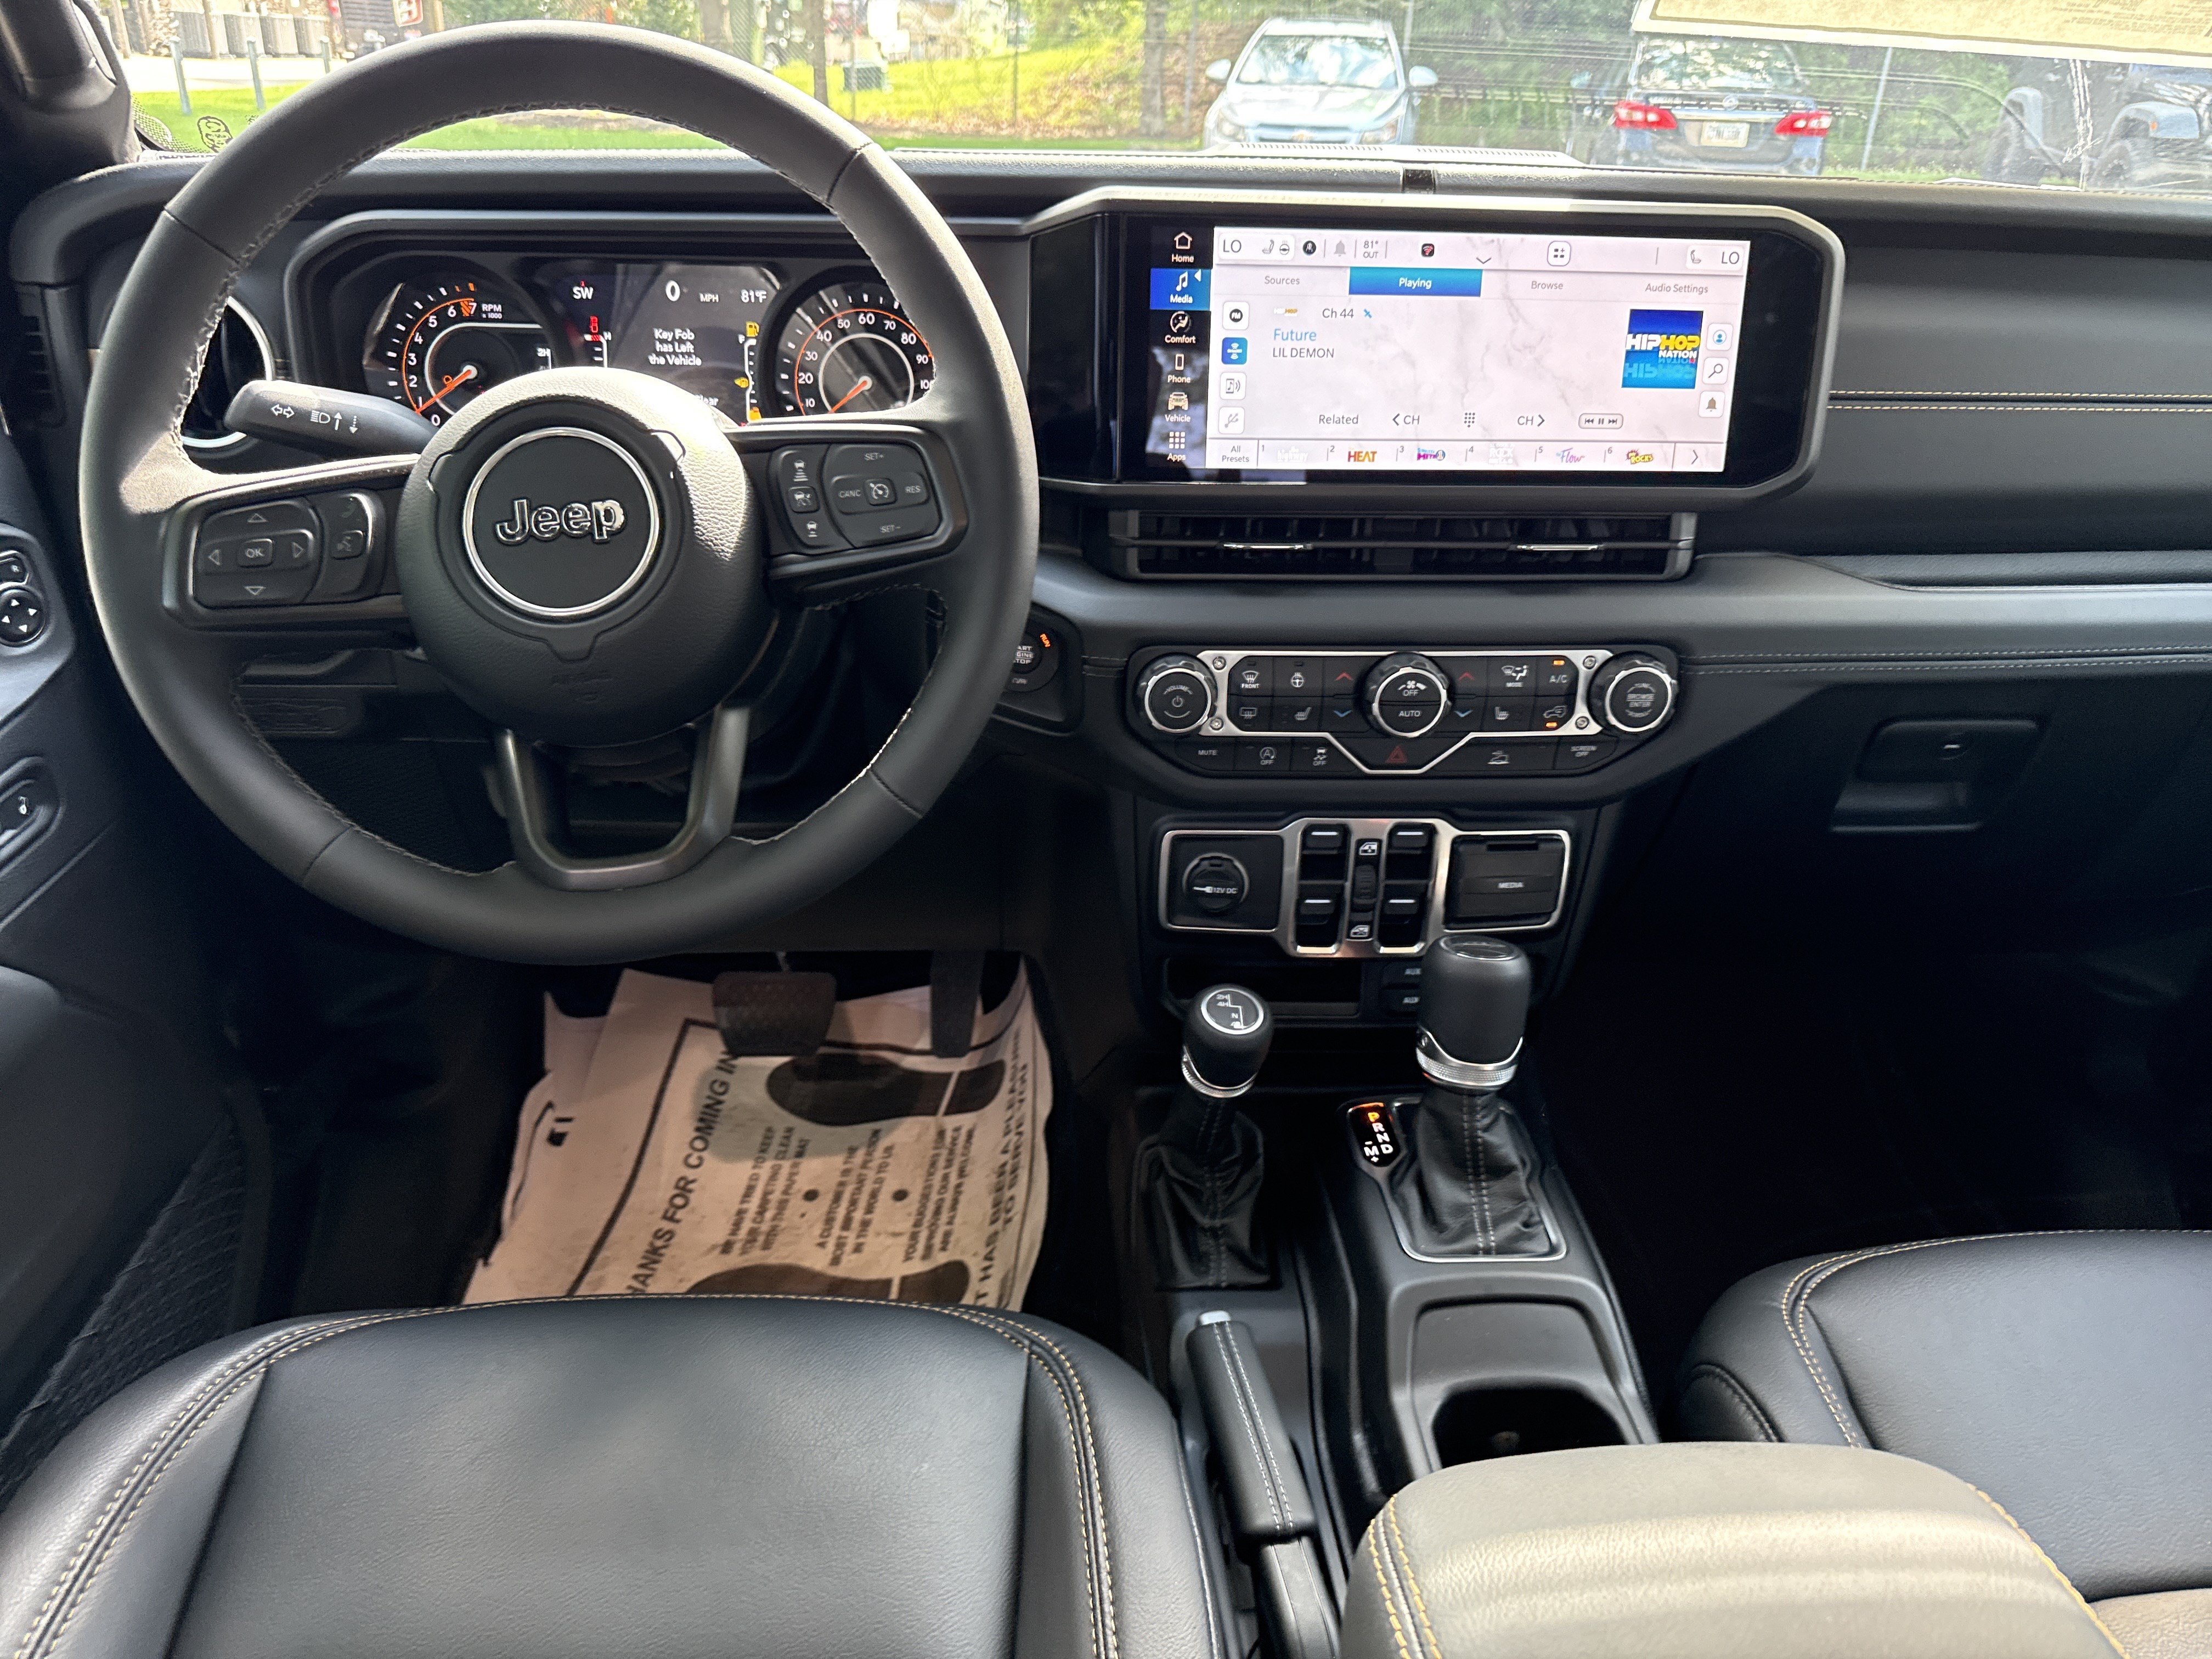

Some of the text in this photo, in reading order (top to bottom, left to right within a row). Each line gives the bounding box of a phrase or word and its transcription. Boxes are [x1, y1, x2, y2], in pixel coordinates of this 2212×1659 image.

[1223, 240, 1242, 253] LO
[1171, 253, 1194, 263] Home
[1721, 252, 1740, 265] LO
[1265, 276, 1300, 285] Sources
[1399, 278, 1432, 289] Playing
[1531, 281, 1564, 290] Browse
[573, 286, 593, 299] SW
[665, 280, 680, 301] 0
[1645, 284, 1708, 295] Audio Settings
[699, 293, 719, 303] MPH
[1170, 295, 1193, 304] Media
[448, 306, 456, 318] 6
[469, 303, 477, 314] 7
[482, 303, 502, 313] RPM
[1322, 308, 1354, 318] Ch 44
[428, 316, 437, 328] 5
[837, 319, 850, 329] 50
[858, 314, 875, 325] 60
[884, 320, 896, 330] 70
[414, 333, 423, 344] 4
[654, 329, 695, 341] Key Fob
[816, 331, 832, 342] 40
[901, 333, 916, 345] 80
[1165, 334, 1195, 344] Comfort
[1274, 328, 1317, 341] Future
[656, 342, 695, 353] has Left
[1273, 347, 1335, 358] LIL DEMON
[408, 354, 417, 365] 3
[648, 354, 702, 366] the Vehicle
[805, 352, 818, 362] 30
[916, 354, 929, 364] 90
[1658, 350, 1697, 359] NATION
[409, 376, 417, 387] 2
[798, 373, 814, 384] 20
[1167, 375, 1191, 383] Phone
[805, 398, 815, 408] 10
[431, 415, 441, 426] 0
[1165, 414, 1190, 422] Vehicle
[1319, 415, 1359, 425] Related
[1403, 415, 1420, 425] CH
[1517, 416, 1534, 426] CH
[1167, 453, 1186, 462] Apps
[1222, 455, 1250, 464] Presets
[1347, 450, 1378, 462] HEAT
[1560, 447, 1585, 463] Flow
[838, 489, 861, 498] CANC
[495, 499, 627, 545] Jeep
[245, 548, 264, 558] OK
[1549, 675, 1569, 683] A/C
[1368, 1112, 1380, 1122] P
[1372, 1122, 1385, 1132] R
[758, 1126, 775, 1153] KEEP
[775, 1126, 794, 1160] CLEAN
[1376, 1132, 1390, 1143] N
[662, 1176, 696, 1224] FOR
[684, 1079, 730, 1169] COMING
[1364, 1146, 1379, 1156] M
[1380, 1144, 1393, 1154] D
[978, 1231, 1000, 1282] HAS
[1001, 1139, 1012, 1155] A
[1001, 1194, 1015, 1231] TO
